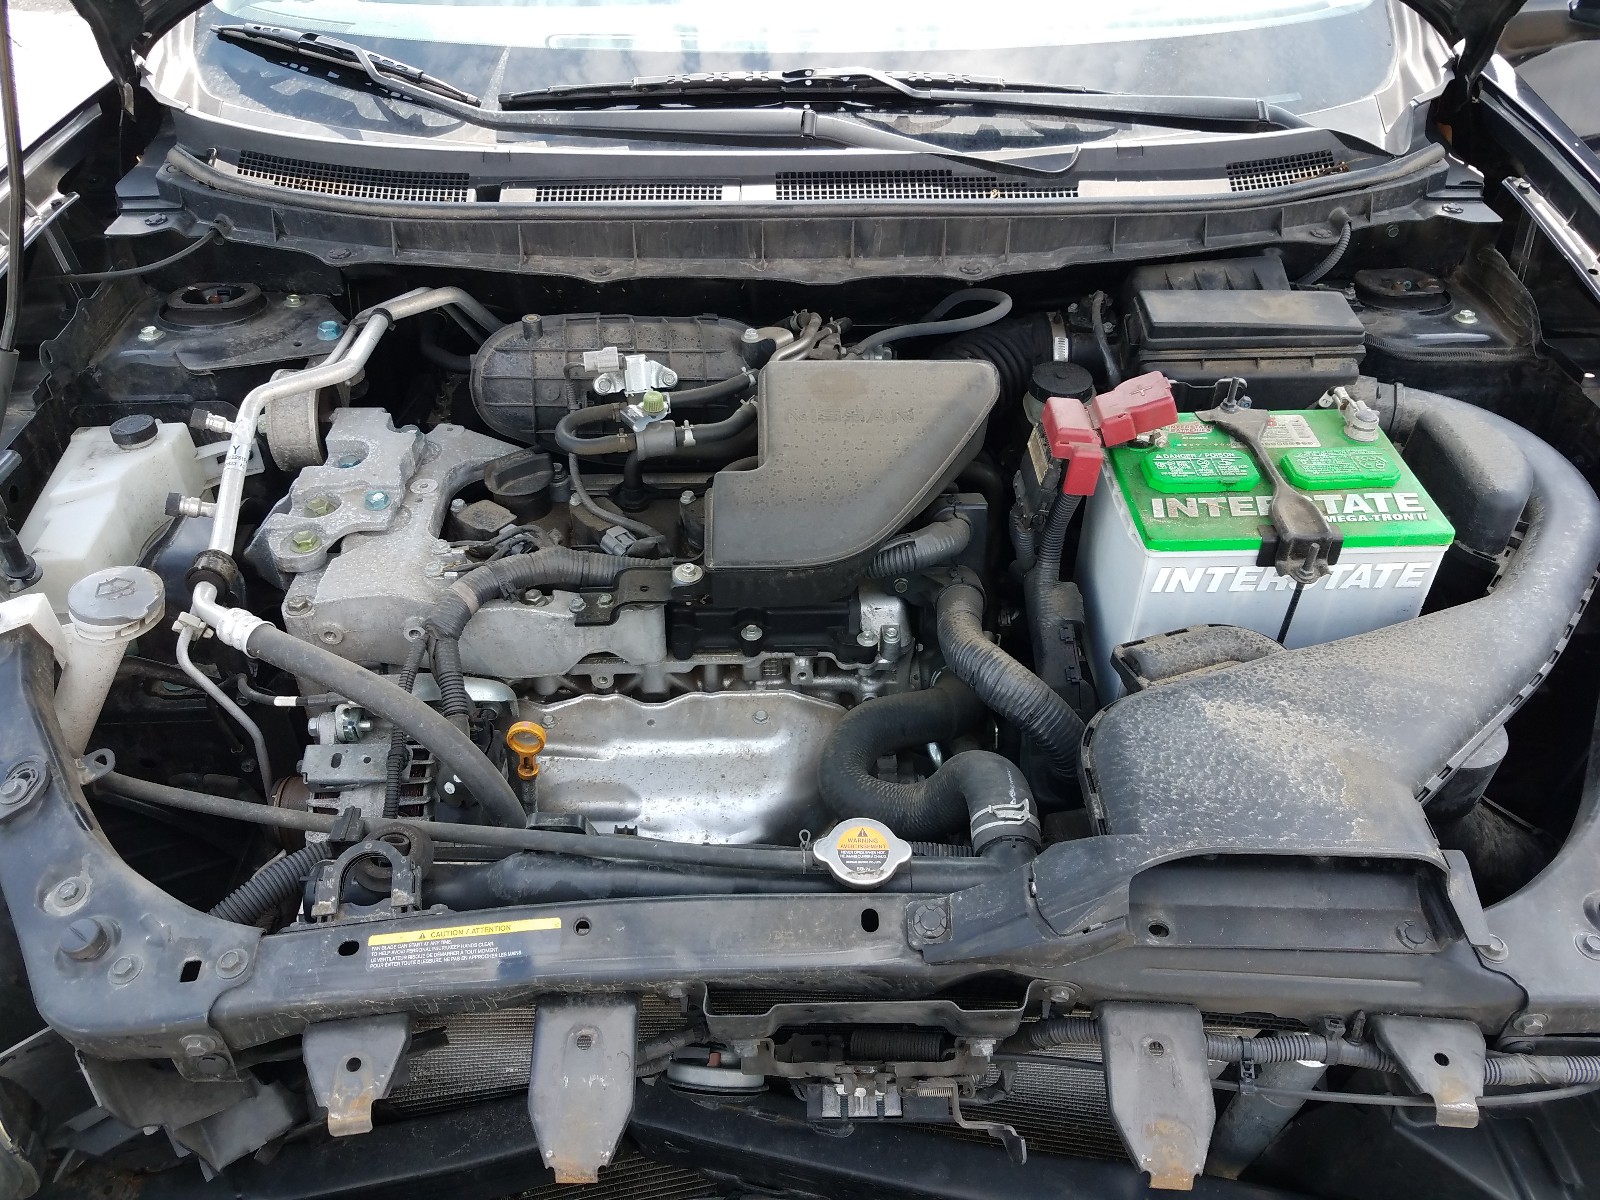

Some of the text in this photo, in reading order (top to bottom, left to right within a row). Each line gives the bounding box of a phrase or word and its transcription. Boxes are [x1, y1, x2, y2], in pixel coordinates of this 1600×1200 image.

[784, 408, 915, 424] NISSAN
[232, 445, 240, 454] Y
[1150, 493, 1426, 518] INTETATE
[1150, 562, 1433, 593] INTERTATE
[430, 929, 464, 938] CAUTION
[471, 924, 512, 934] ATTENTION
